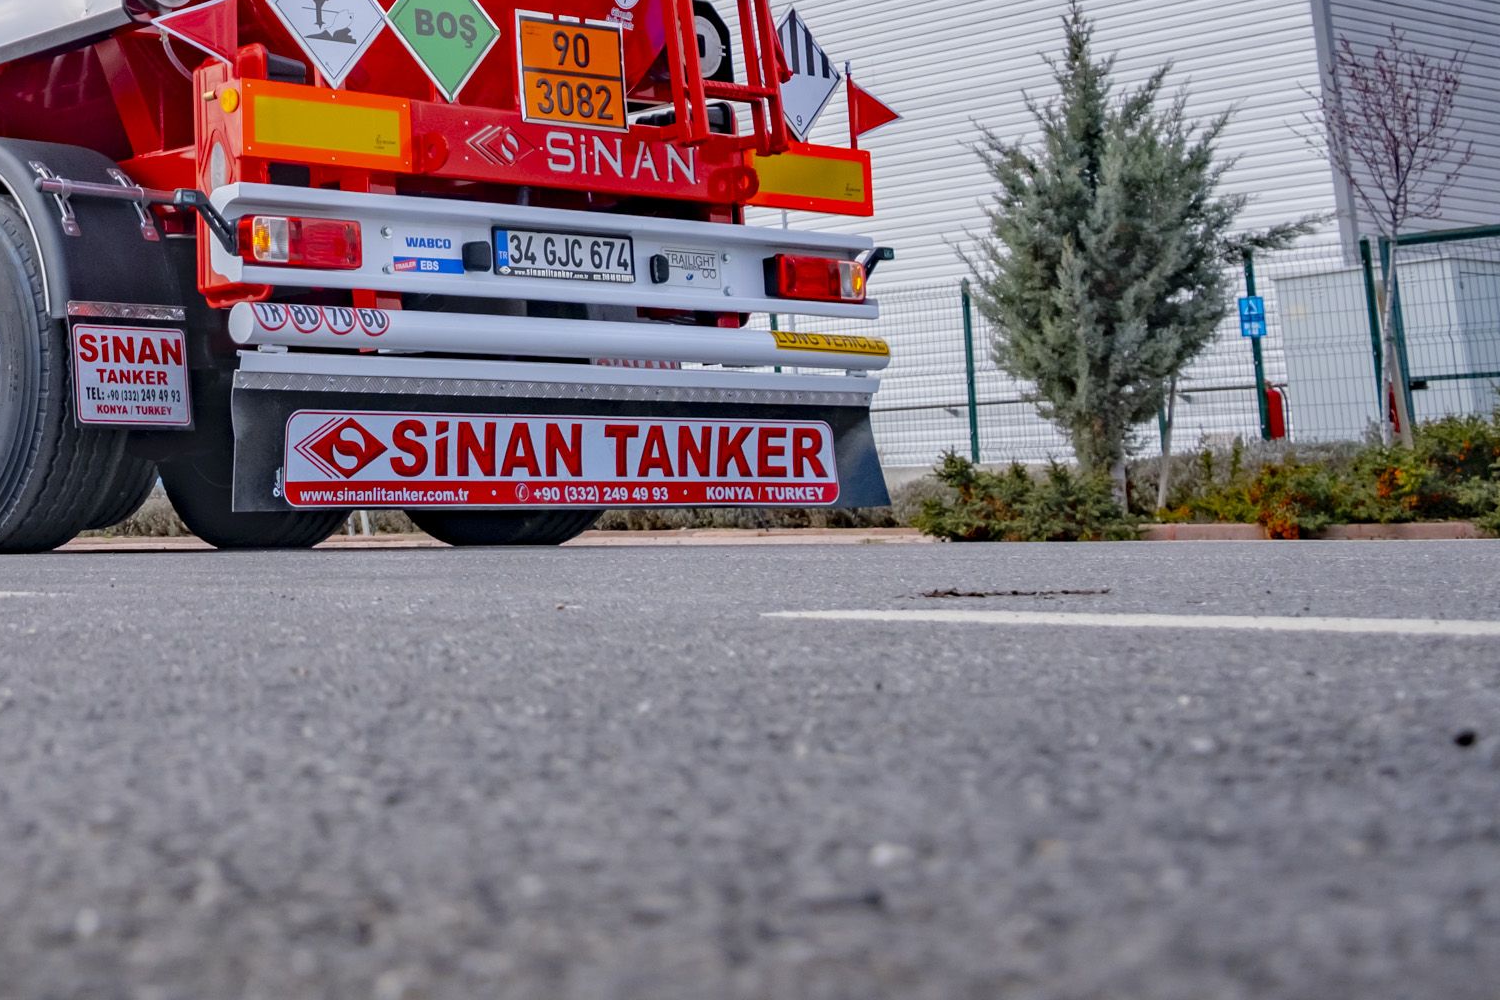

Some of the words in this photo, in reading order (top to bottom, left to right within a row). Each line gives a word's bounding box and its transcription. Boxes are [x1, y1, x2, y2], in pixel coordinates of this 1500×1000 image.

[414, 8, 478, 49] BOŞ
[552, 31, 590, 68] 90
[536, 79, 614, 120] 3082
[796, 115, 803, 127] 9
[405, 236, 452, 249] WABCO
[498, 250, 508, 259] TR
[510, 234, 537, 265] 34
[544, 236, 583, 268] GJC
[590, 240, 630, 271] 674
[420, 260, 440, 271] EBS
[256, 303, 284, 322] TR
[290, 304, 319, 326] 80
[324, 307, 353, 327] 70
[360, 308, 386, 329] 60
[95, 368, 169, 386] TANKER
[86, 387, 105, 401] TEL:
[107, 389, 120, 401] +90
[121, 390, 140, 403] (332)
[141, 388, 156, 402] 249
[158, 389, 169, 402] 49
[171, 390, 181, 403] 93
[96, 404, 129, 415] KONYA
[135, 405, 173, 416] TURKEY
[604, 423, 829, 478] TANKER
[299, 487, 469, 502] www.sinanlitanker.com.tr
[533, 487, 560, 501] +90
[564, 485, 599, 502] (332)
[603, 486, 628, 501] 249
[632, 486, 649, 501] 49
[653, 486, 668, 501] 93
[705, 486, 754, 500] KONYA
[765, 486, 825, 500] TURKEY
